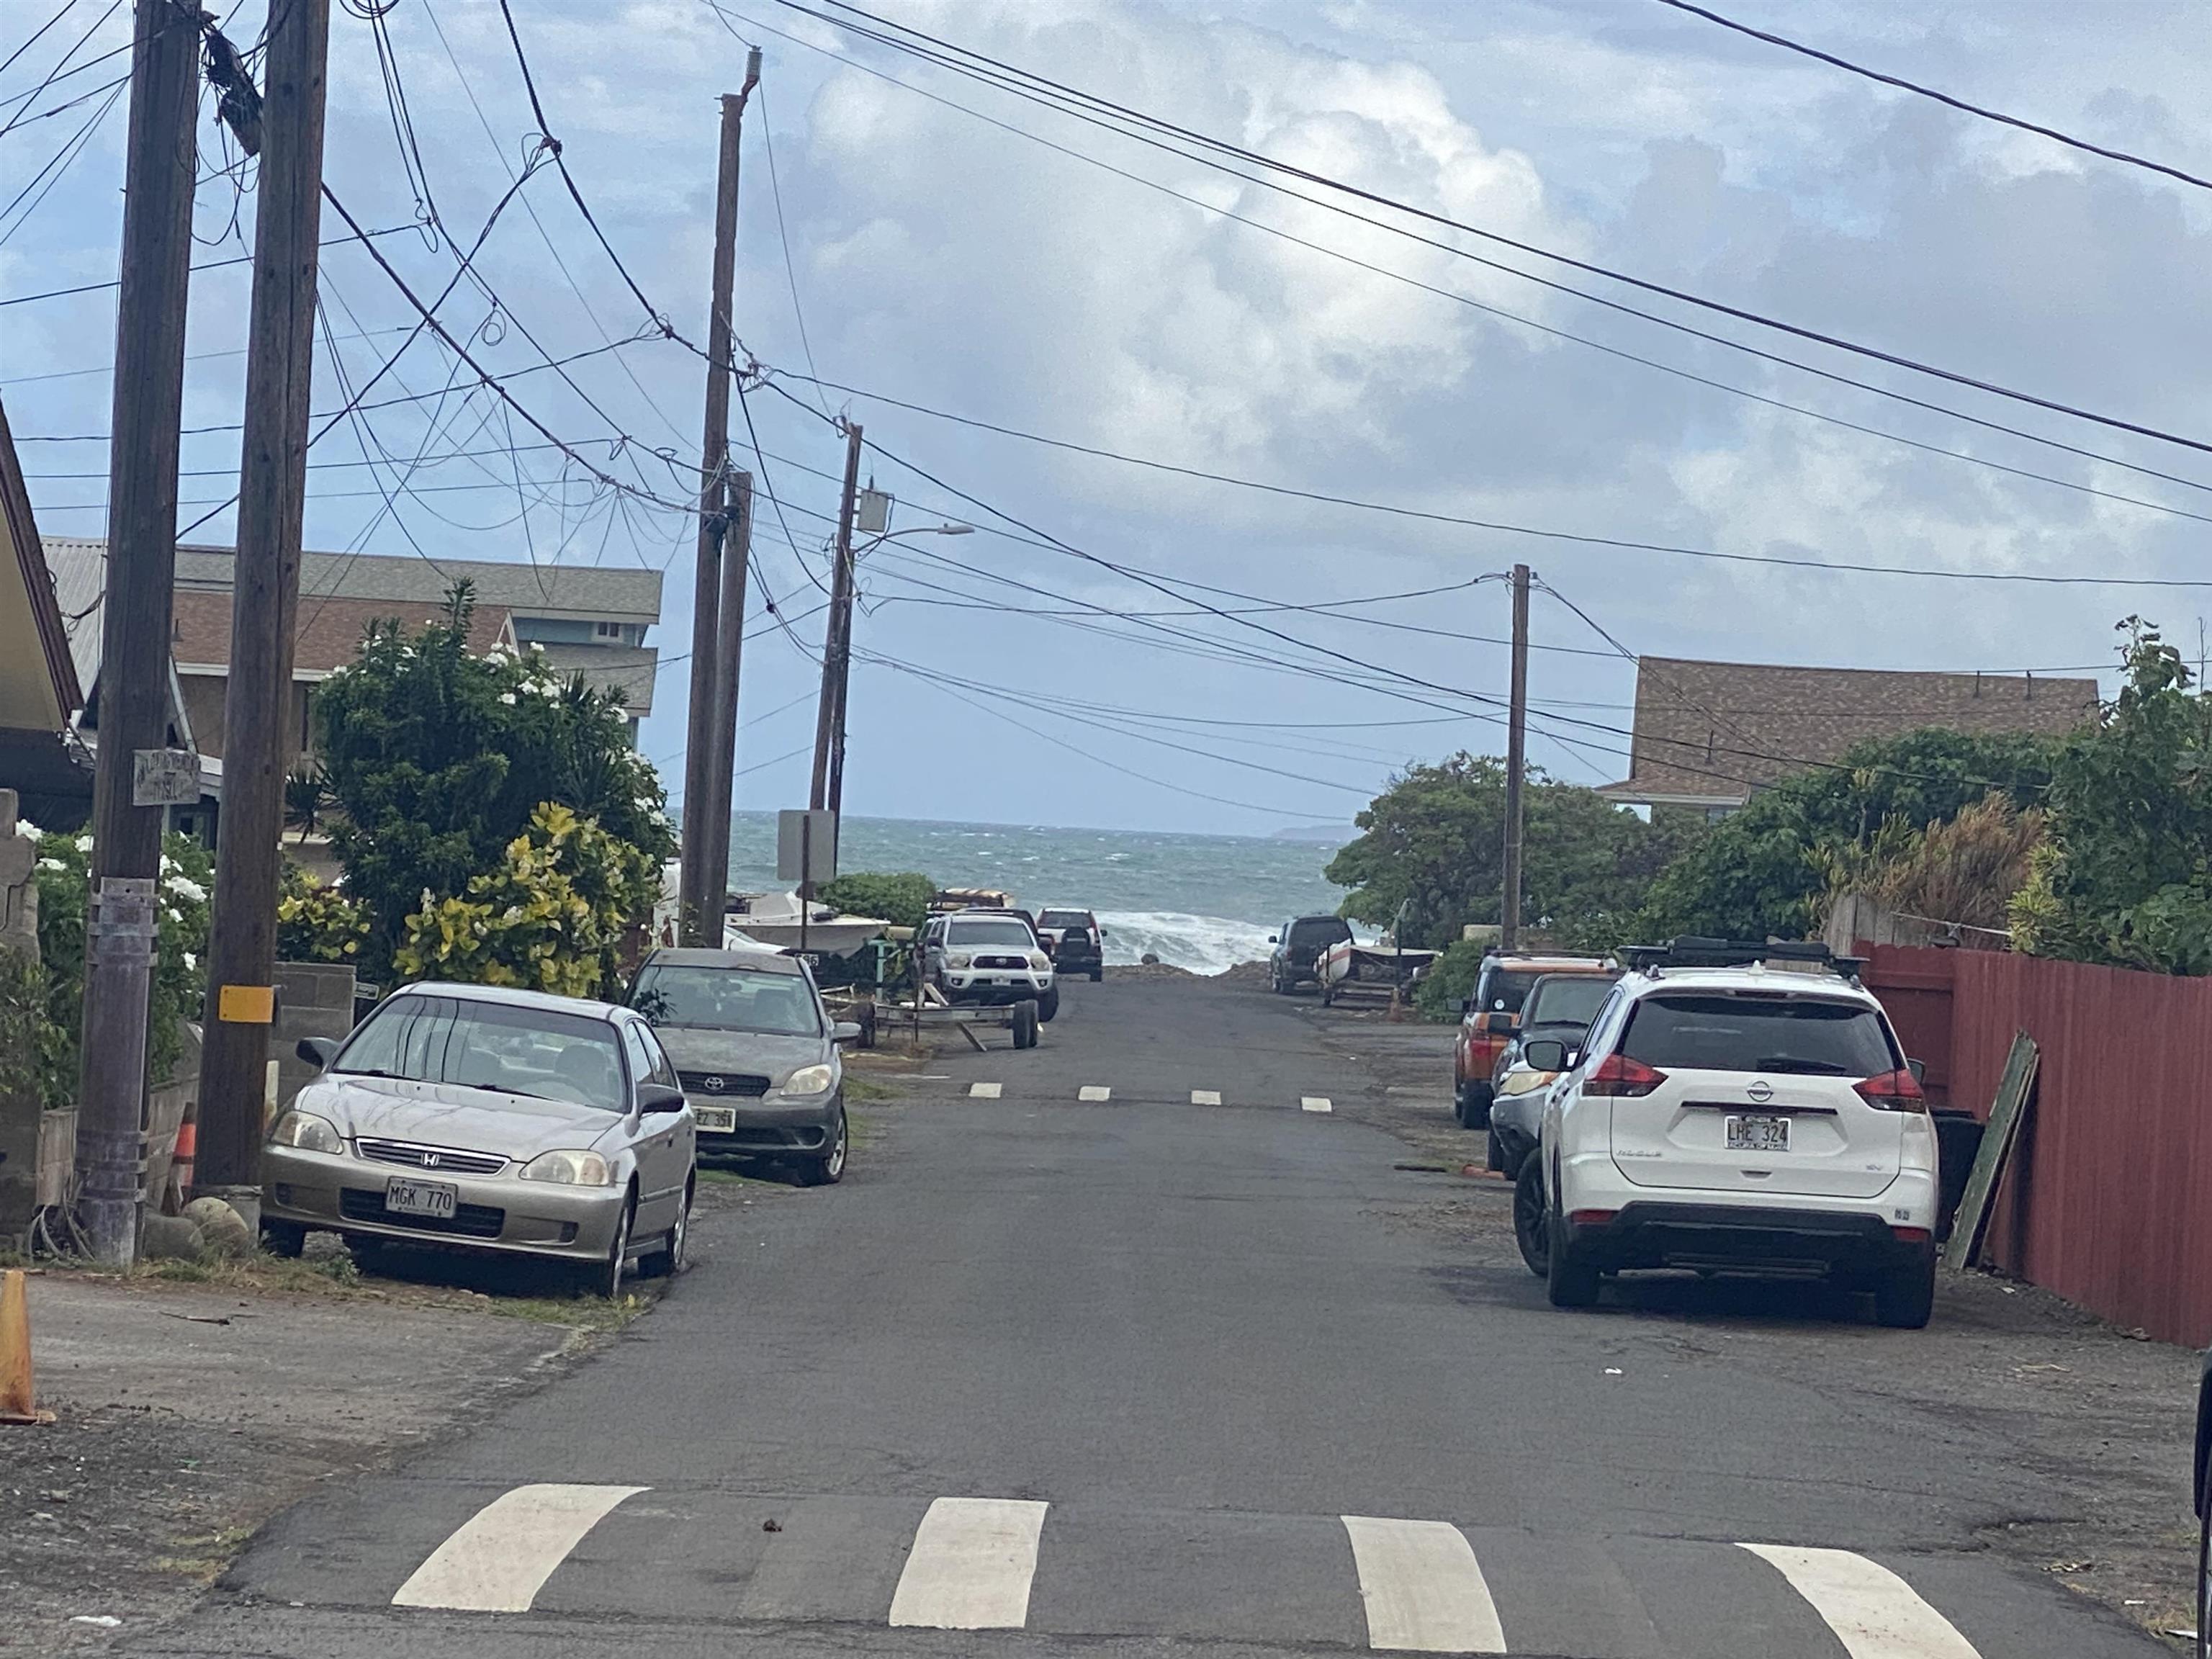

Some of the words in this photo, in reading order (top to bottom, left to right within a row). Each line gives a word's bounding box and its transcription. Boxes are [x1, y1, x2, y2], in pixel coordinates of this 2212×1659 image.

[1728, 1123, 1753, 1141] LHE
[1761, 1124, 1787, 1143] 324
[389, 1185, 416, 1206] MGK
[426, 1190, 452, 1210] 770
